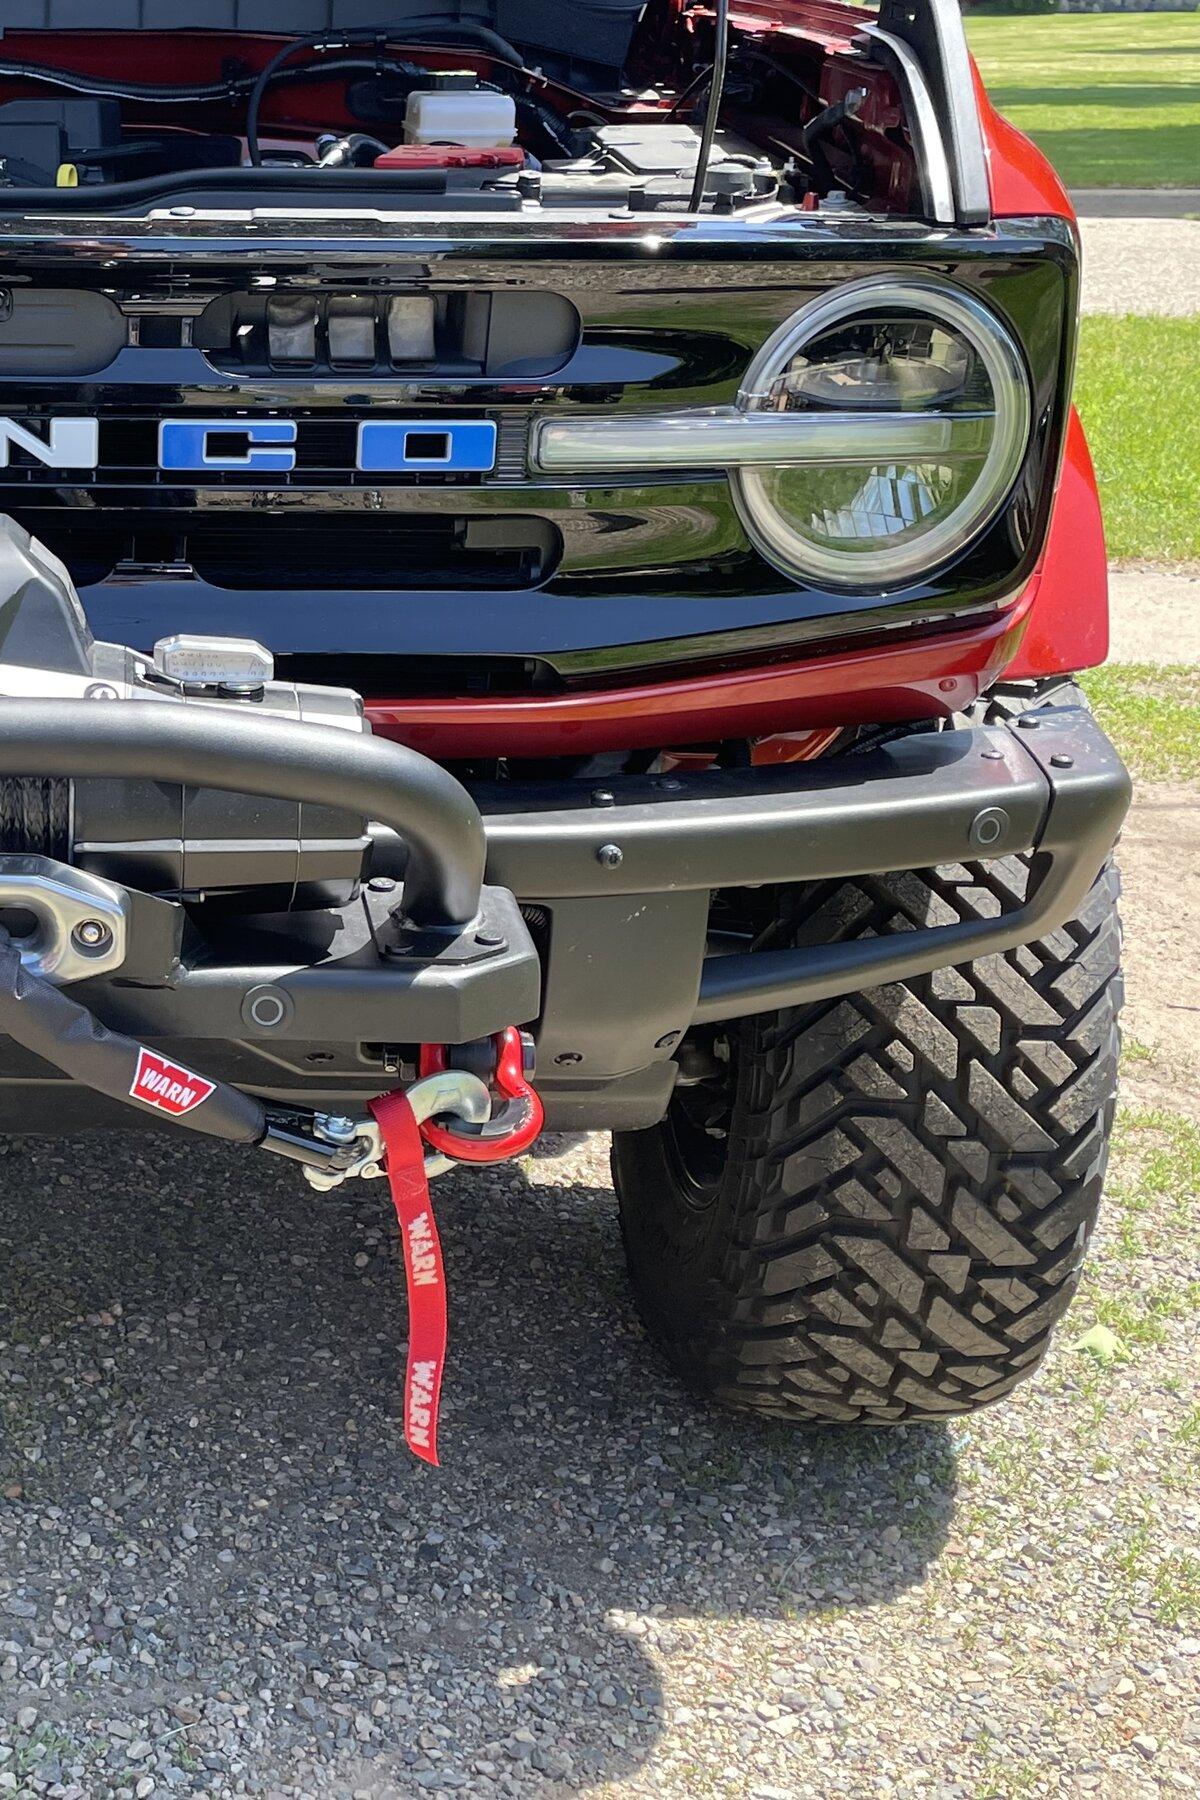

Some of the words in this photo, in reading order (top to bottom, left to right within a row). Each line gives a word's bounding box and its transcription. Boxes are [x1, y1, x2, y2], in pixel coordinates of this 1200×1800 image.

[140, 1067, 197, 1107] WARN
[408, 1212, 439, 1287] WARN
[410, 1361, 437, 1448] WARN
